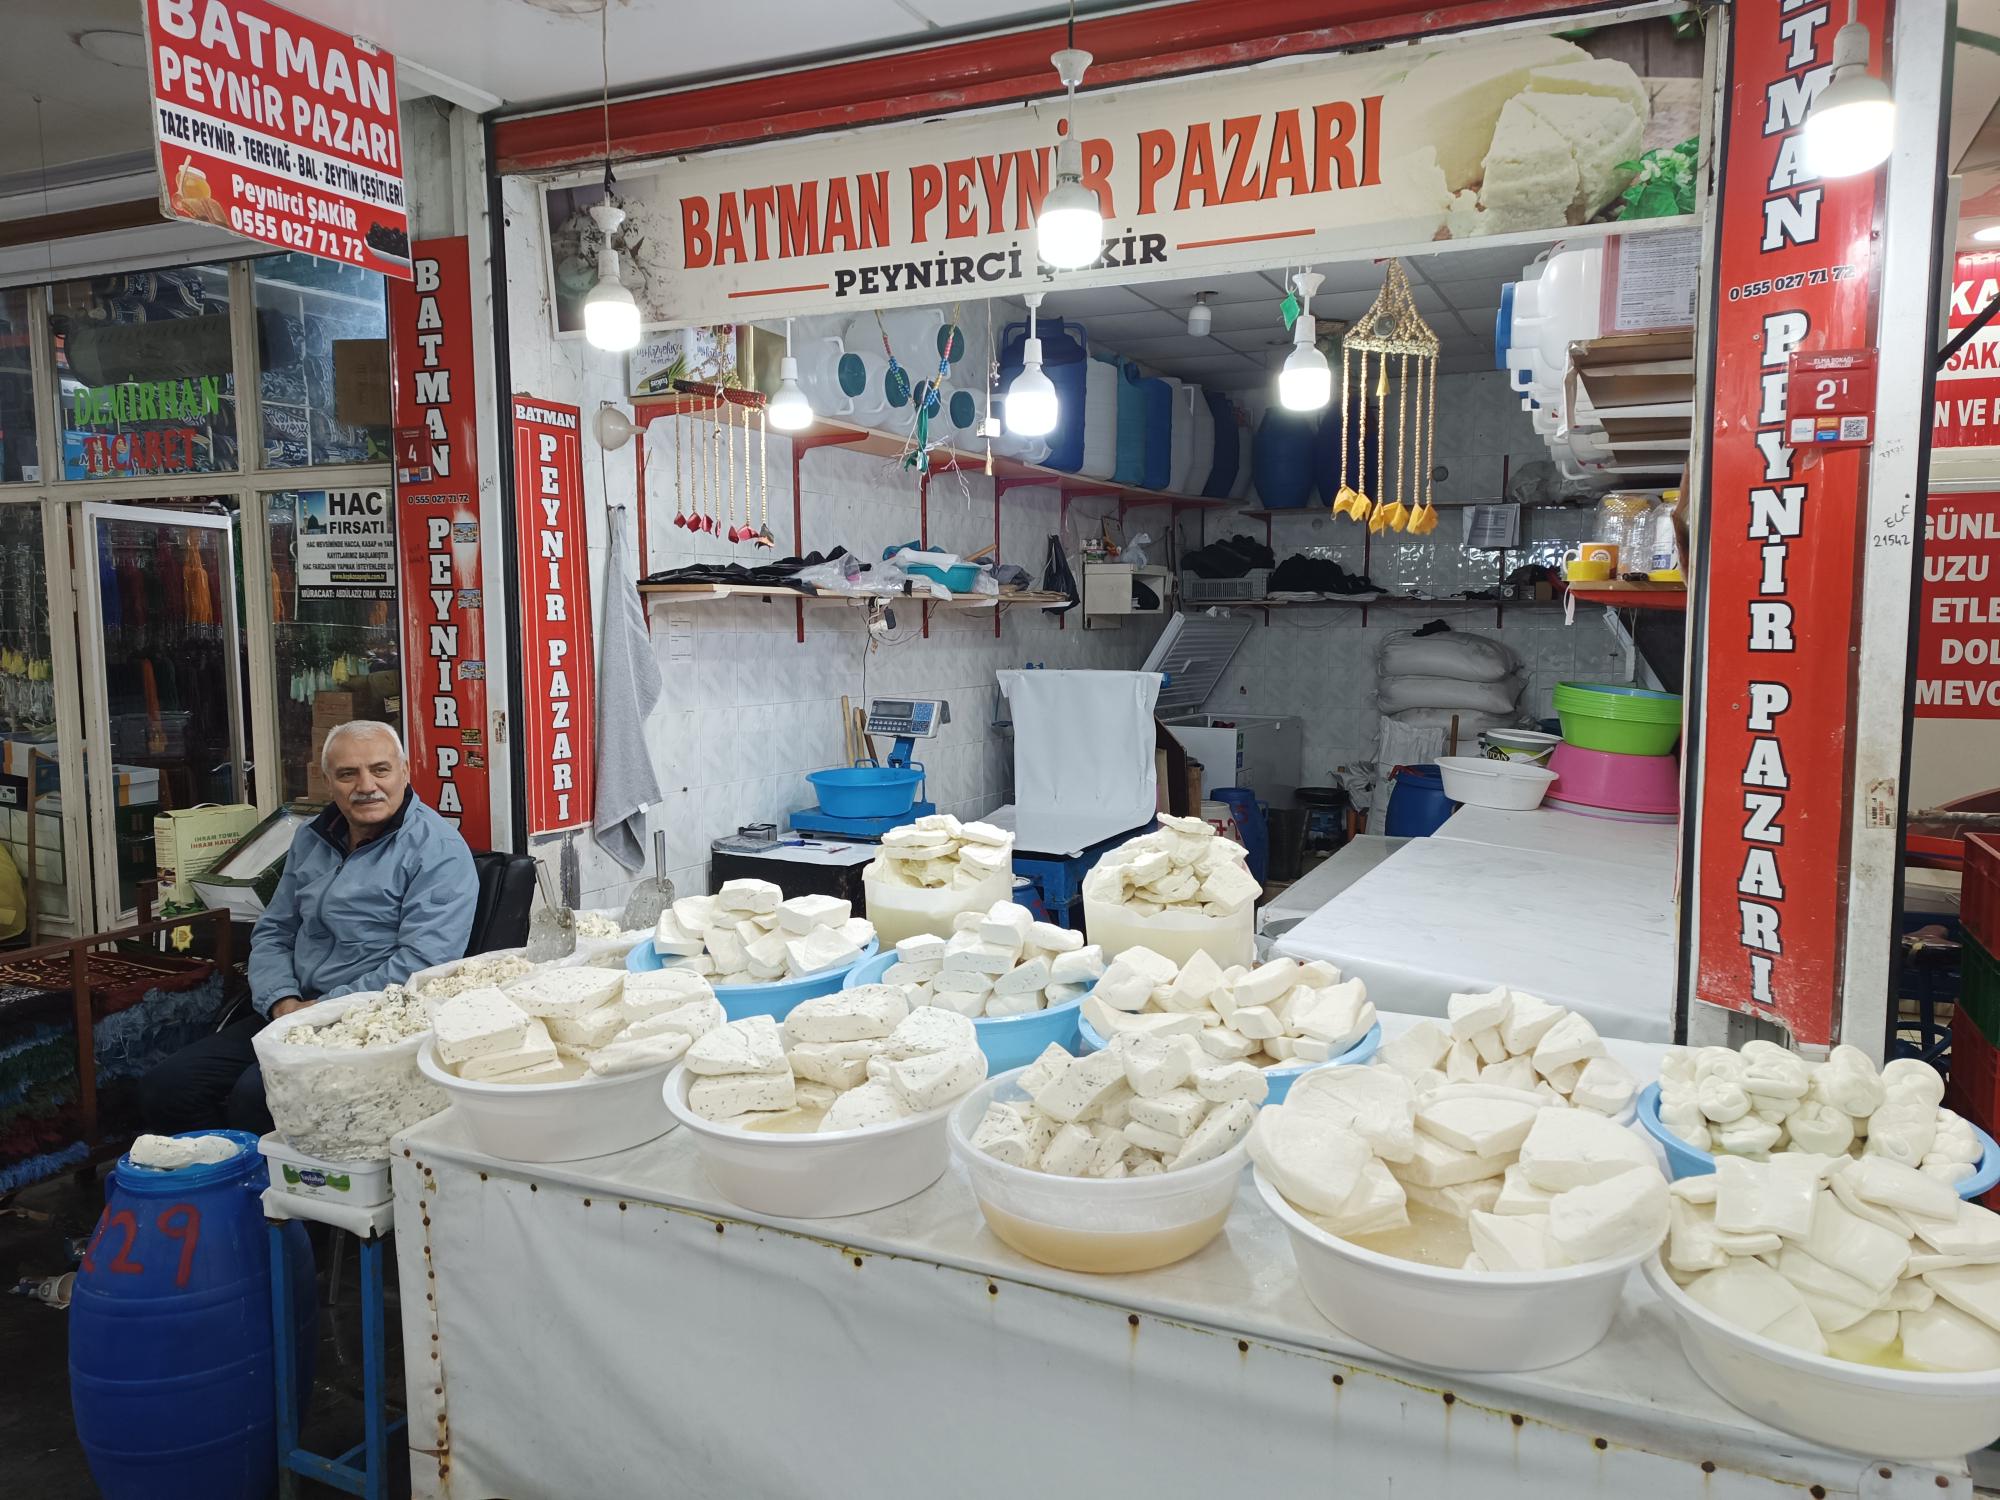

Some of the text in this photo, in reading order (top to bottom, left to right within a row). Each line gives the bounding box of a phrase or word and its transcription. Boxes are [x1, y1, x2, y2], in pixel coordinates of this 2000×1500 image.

[158, 0, 390, 115] BATMAN
[159, 45, 397, 168] PEYNİR PAZARI
[1761, 0, 1834, 251] TMAN
[160, 109, 404, 208] TAZE PEYNİR TEREYAĞ BAL ZEYTİN ÇEŞİTLERİ
[680, 95, 1384, 270] BATMAN PEYNR PAZARI
[231, 206, 364, 262] 0555 027 71 72
[232, 174, 357, 232] Peynirci ŞAKİR
[835, 228, 1167, 298] PEYNİRCİ KİR
[1729, 287, 1740, 302] 0
[1742, 281, 1770, 300] 555
[1775, 274, 1804, 293] 027
[1809, 268, 1828, 286] 71
[415, 259, 450, 477] BATMAN
[515, 404, 576, 429] BATMAN
[1957, 399, 1986, 427] VE
[408, 443, 417, 462] 4
[329, 492, 382, 515] HAC
[330, 521, 384, 534] FIRSATI
[408, 496, 415, 504] 0
[415, 495, 430, 505] 555
[432, 495, 446, 504] 027
[458, 493, 469, 503] 72
[1873, 534, 1910, 547] 21542
[428, 518, 458, 728] PEYNİR
[539, 434, 574, 821] PEYNİR PAZARI
[1738, 682, 1791, 1004] PAZARI
